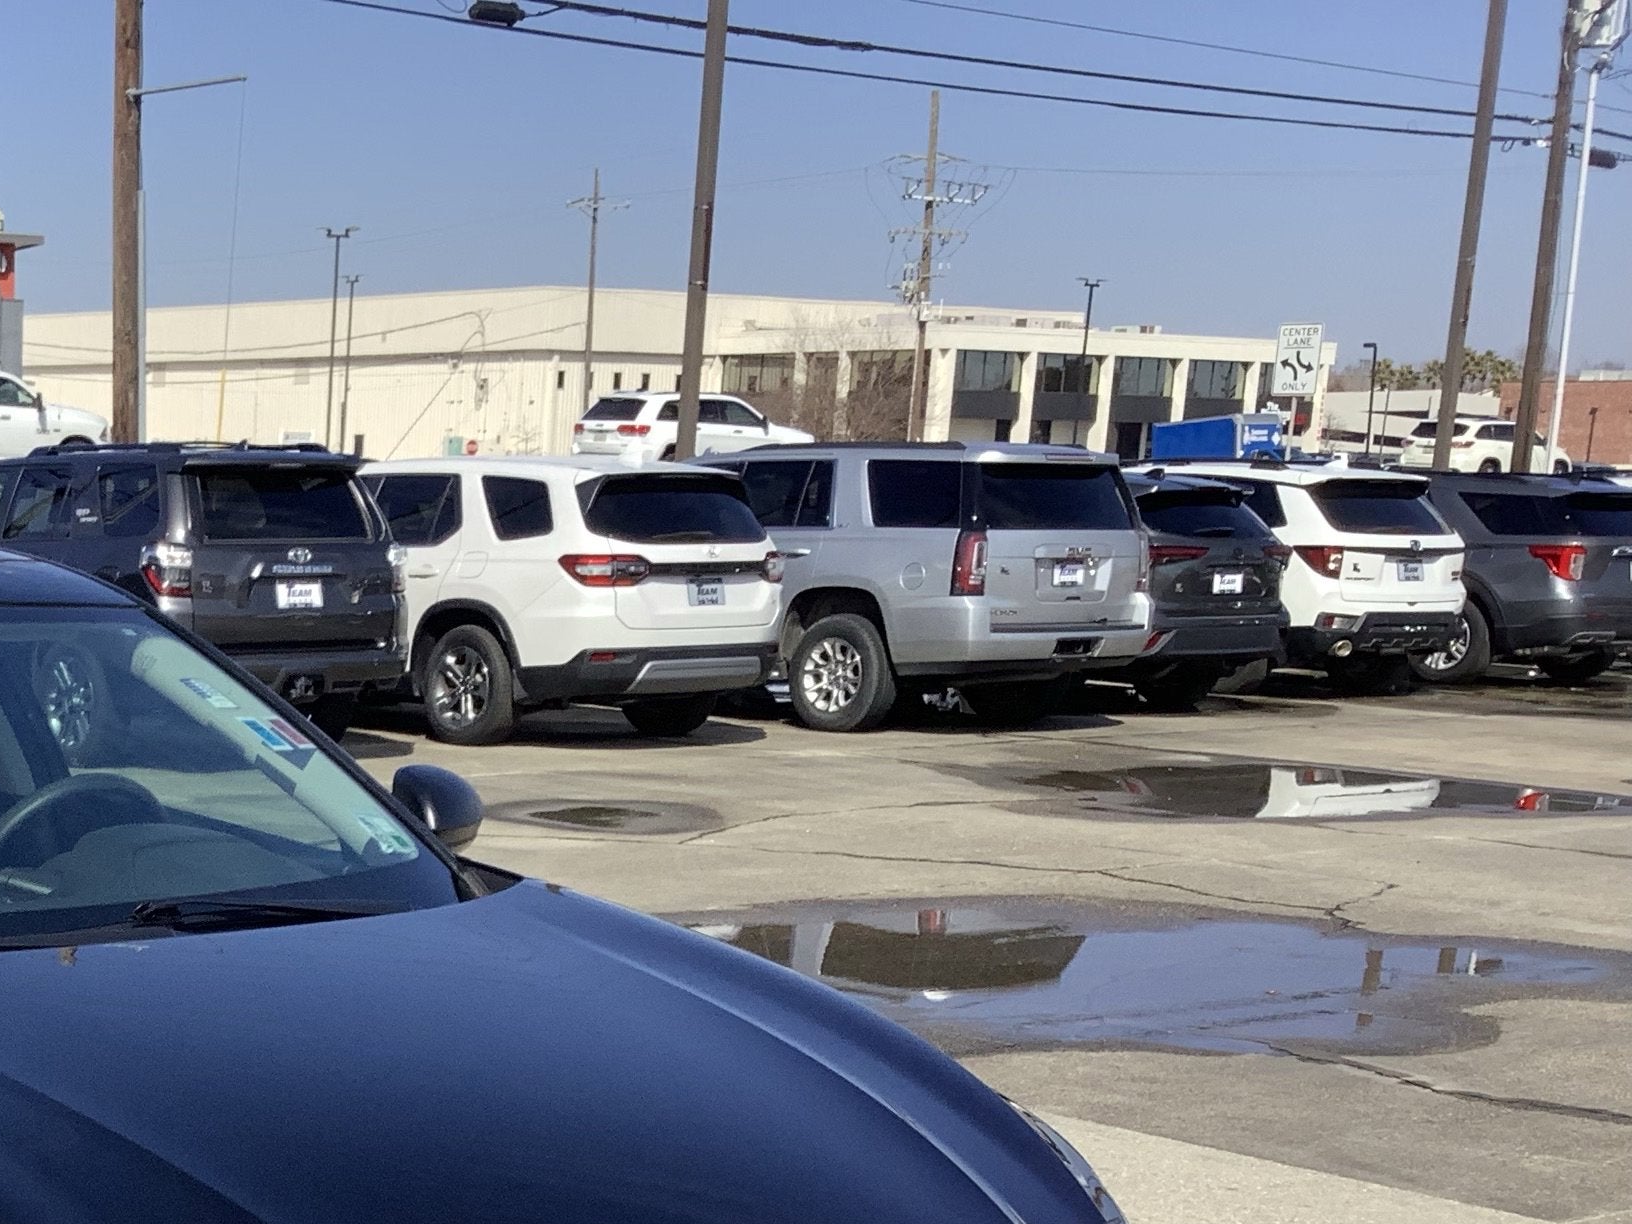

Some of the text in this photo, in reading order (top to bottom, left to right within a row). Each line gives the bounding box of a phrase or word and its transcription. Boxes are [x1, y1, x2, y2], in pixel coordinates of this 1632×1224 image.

[1282, 328, 1319, 336] CENTER
[1287, 337, 1312, 347] LANE
[1281, 383, 1308, 391] ONLY
[287, 580, 313, 598] TEAM
